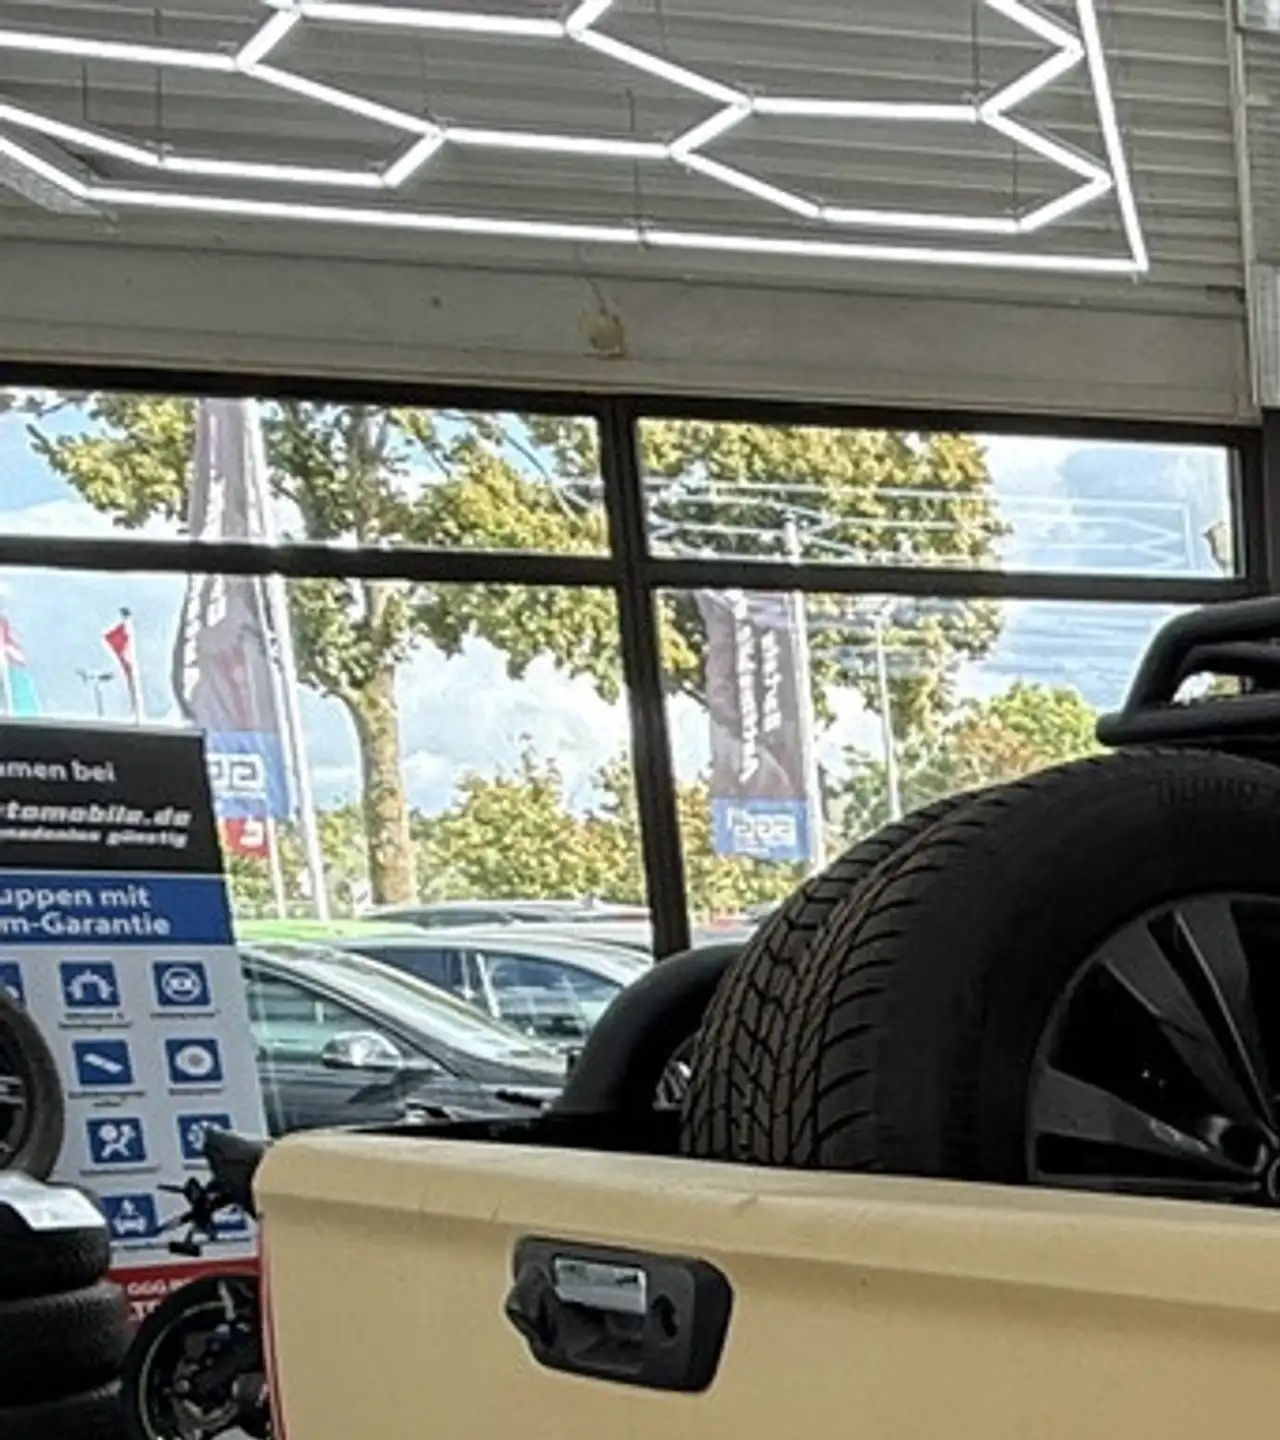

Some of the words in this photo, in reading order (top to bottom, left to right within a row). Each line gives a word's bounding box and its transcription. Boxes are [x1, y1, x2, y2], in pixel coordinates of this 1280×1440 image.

[71, 760, 117, 783] bei
[0, 799, 192, 827] tomobile.de
[99, 884, 151, 909] mit
[0, 911, 171, 937] m-Garantie
